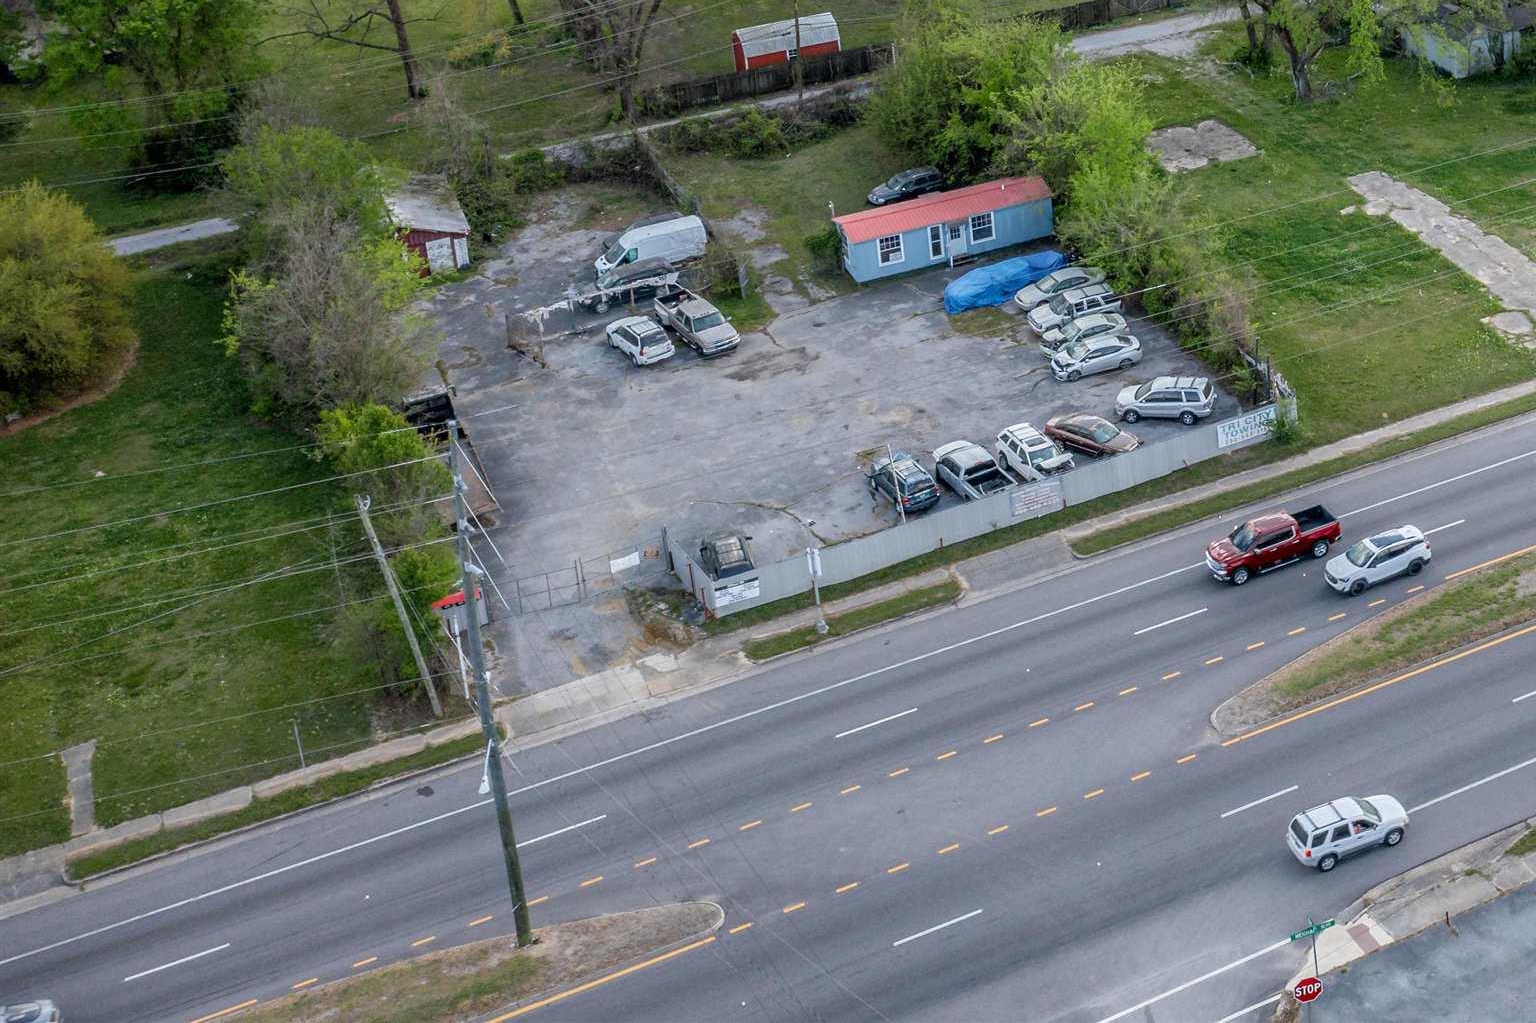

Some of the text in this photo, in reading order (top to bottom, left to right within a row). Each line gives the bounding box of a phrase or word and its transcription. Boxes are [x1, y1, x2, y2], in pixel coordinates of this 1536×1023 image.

[1220, 409, 1272, 433] TRI CITY
[1224, 418, 1273, 437] TOWING
[1295, 982, 1321, 997] STOP
